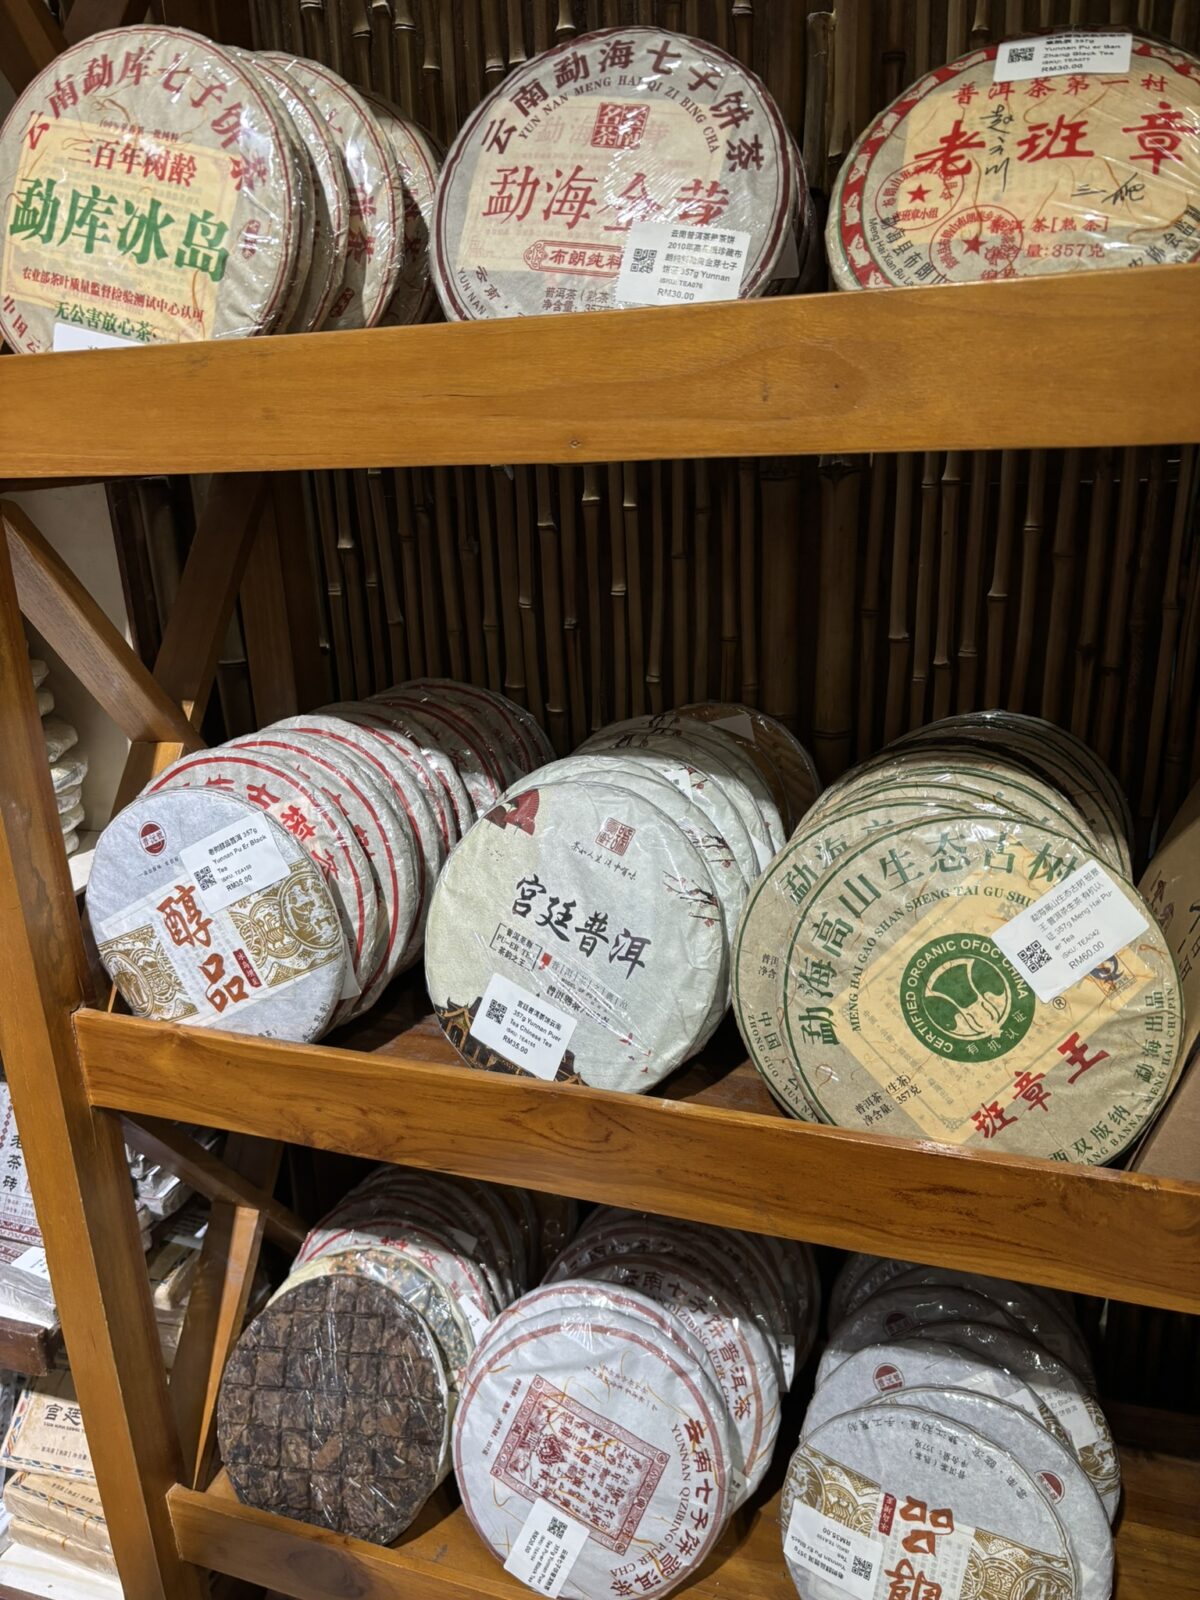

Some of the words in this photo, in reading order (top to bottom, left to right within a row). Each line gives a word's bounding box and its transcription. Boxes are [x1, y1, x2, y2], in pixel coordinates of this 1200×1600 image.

[953, 73, 1168, 106] 普洱茶第一村
[481, 39, 766, 172] 云南勐海七子饼茶
[517, 116, 541, 141] YUN
[541, 94, 570, 117] NAN
[573, 76, 612, 97] MENG
[664, 86, 679, 100] ZI
[679, 97, 708, 125] BING
[702, 125, 720, 153] CHA
[914, 101, 1200, 178] 老班章
[67, 139, 198, 188] 三百年树龄
[9, 177, 230, 282] 勐库冰岛
[869, 217, 880, 242] Meng
[548, 246, 623, 268] 布朗纯料
[875, 240, 888, 256] Hai
[881, 253, 898, 272] Xian
[701, 271, 730, 283] Yunnan
[656, 287, 695, 301] RM30.00
[213, 851, 234, 865] Yunnan
[249, 834, 267, 846] Black
[216, 866, 228, 874] Tea
[226, 874, 253, 892] RM35.00
[903, 889, 952, 914] SHENG
[953, 885, 981, 899] TAI
[982, 885, 1006, 900] GU
[511, 873, 652, 980] 宫廷普洱
[874, 907, 904, 939] SHAN
[1054, 920, 1073, 936] 357g
[1070, 907, 1091, 925] Meng
[1090, 898, 1101, 910] Hai
[799, 831, 1078, 1047] 勐海高山生态古树
[856, 936, 878, 965] GAO
[960, 938, 1001, 959] OFDC
[1062, 934, 1075, 945] Tea
[520, 948, 536, 962] TE
[907, 940, 957, 988] ORGANIC
[1068, 940, 1105, 970] RM60.00
[850, 966, 864, 990] HAI
[1001, 957, 1029, 999] CHINA
[512, 1009, 527, 1022] 357g
[527, 1017, 548, 1034] Yunnan
[848, 992, 863, 1034] MENG
[905, 991, 954, 1053] CERTIFIED
[509, 1018, 519, 1028] Tea
[519, 1024, 541, 1042] Chinese
[502, 1034, 529, 1055] RM35.00
[971, 1031, 1110, 1139] 班章王
[44, 1403, 81, 1427] 宫廷
[671, 1423, 691, 1482] YUNNAN
[610, 1418, 713, 1597] 云南七子饼普洱茶
[663, 1485, 690, 1545] QIZIBING
[822, 1527, 852, 1547] RM35.00
[639, 1541, 666, 1568] PUER
[609, 1560, 638, 1578] CHA
